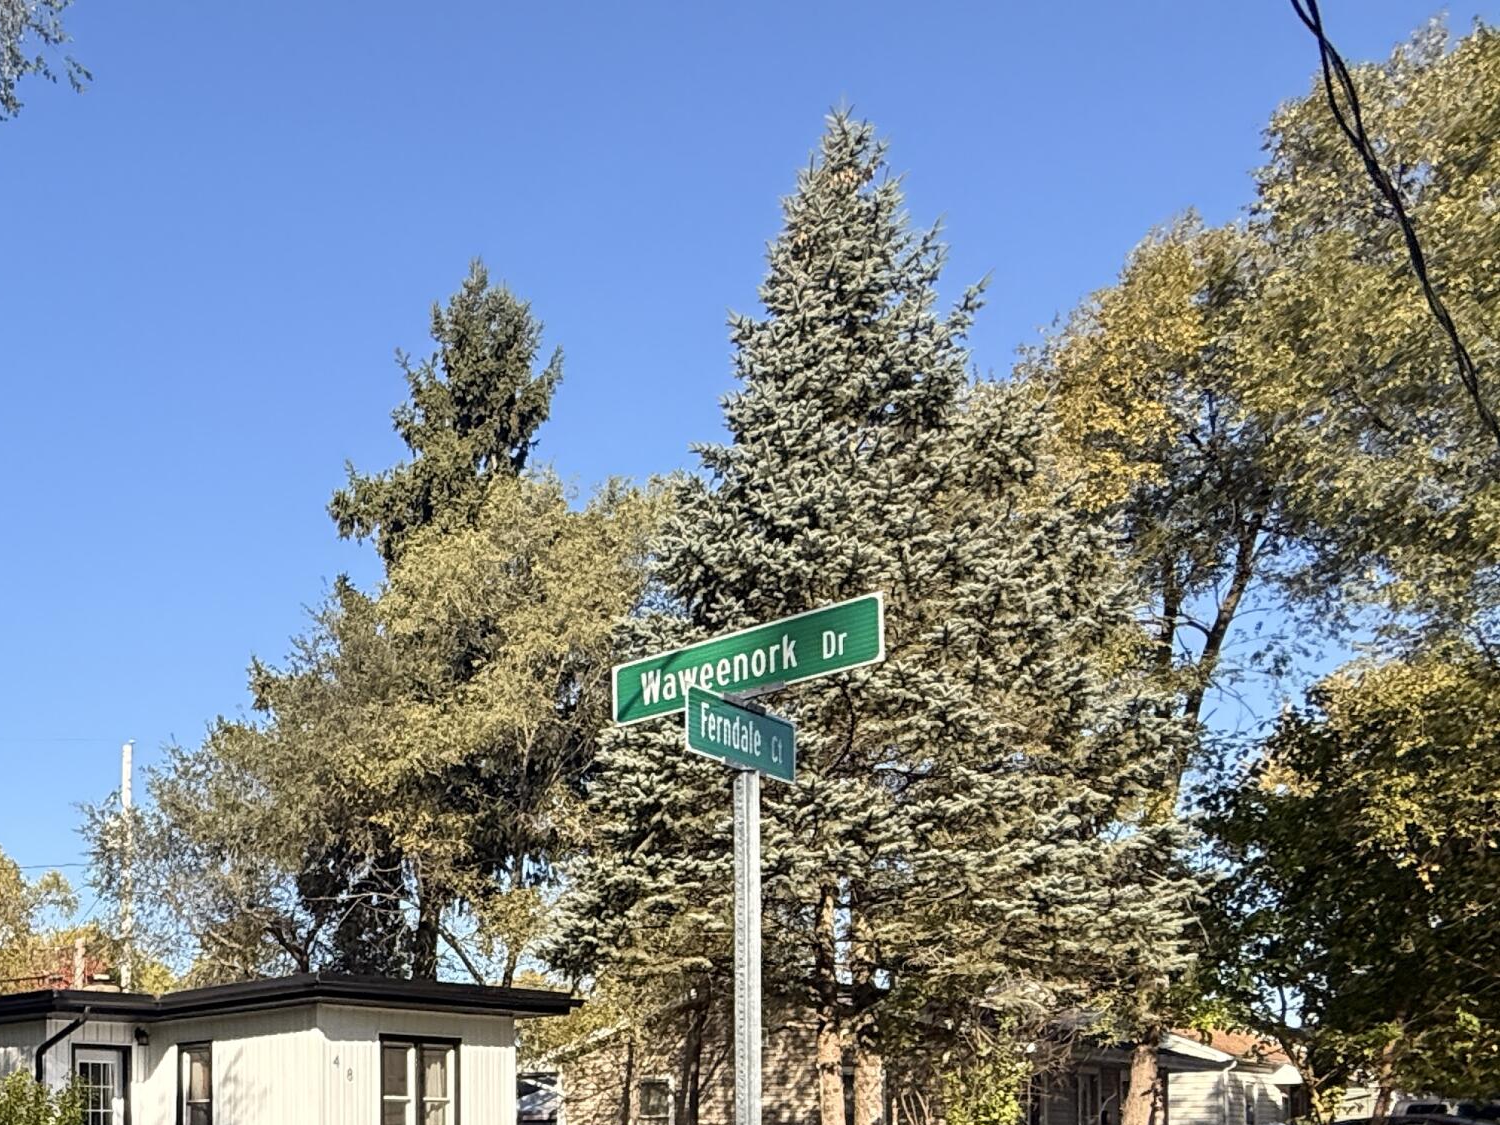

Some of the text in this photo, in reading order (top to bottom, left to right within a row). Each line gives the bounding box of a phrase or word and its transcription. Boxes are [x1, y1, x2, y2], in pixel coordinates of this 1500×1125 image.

[641, 630, 847, 706] Waweenork Dr
[701, 701, 783, 764] Ferndale Ct
